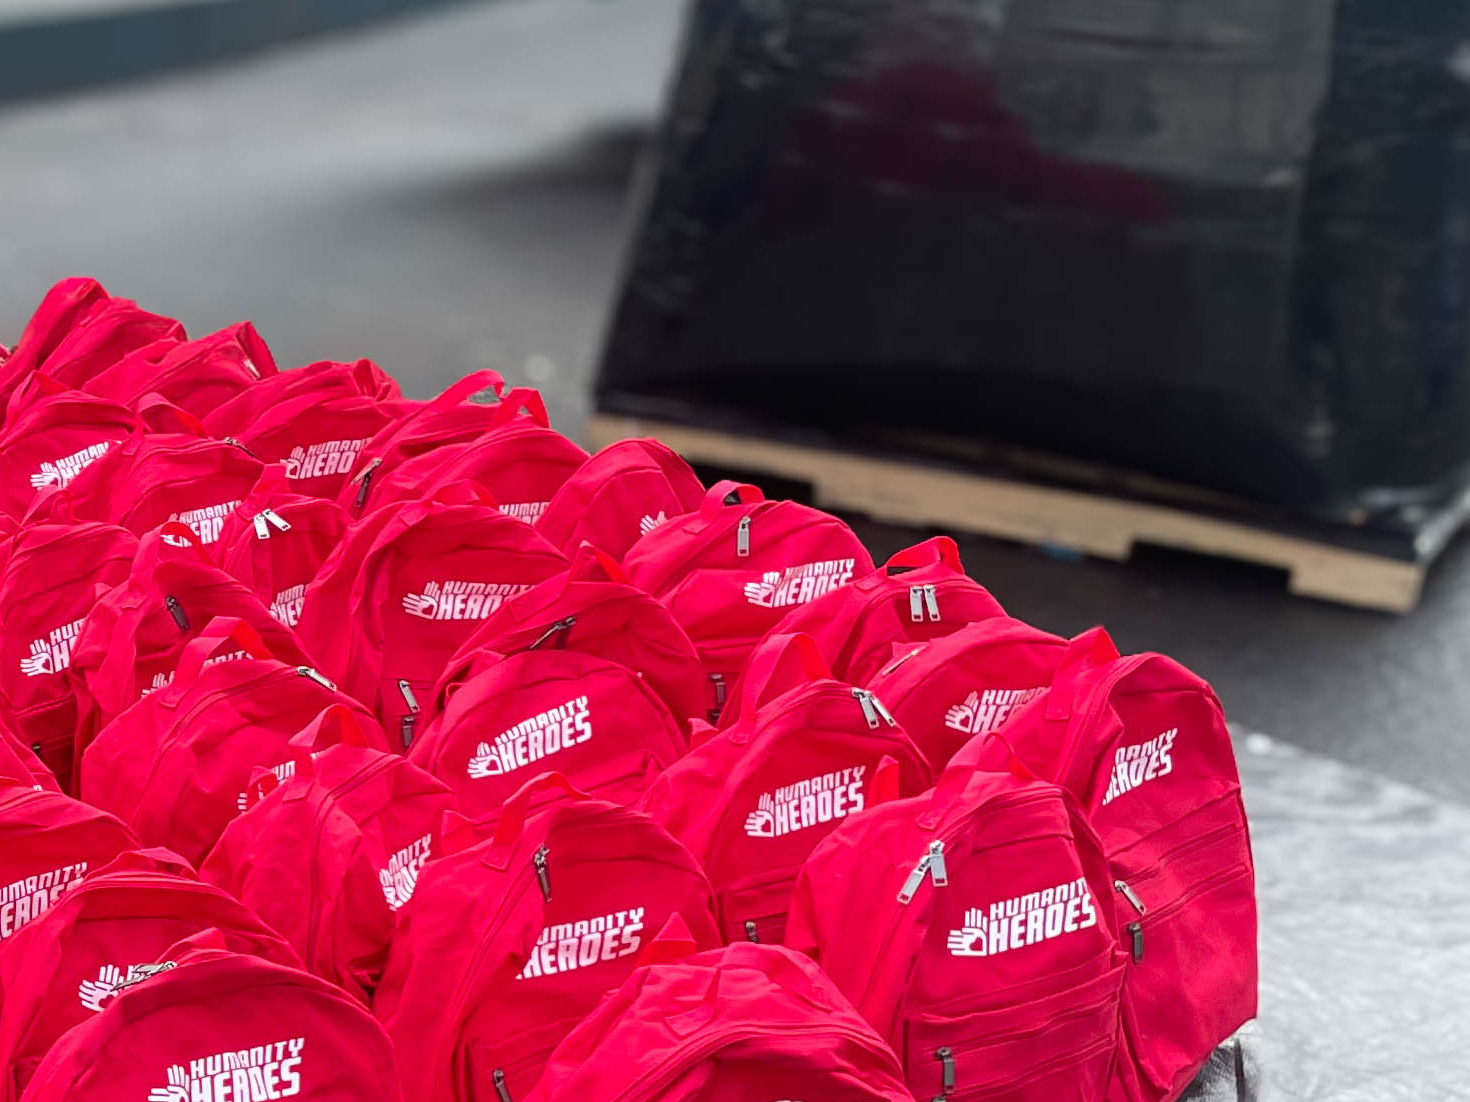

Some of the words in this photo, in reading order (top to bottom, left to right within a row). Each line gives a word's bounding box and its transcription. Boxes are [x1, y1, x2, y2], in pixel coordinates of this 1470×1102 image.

[301, 450, 357, 480] HERO
[435, 594, 508, 620] HERO
[494, 696, 588, 744] HUMANITY
[498, 711, 592, 773] HEROES
[775, 766, 865, 804] HUMANITY
[775, 780, 864, 837] HEROES
[536, 907, 644, 946] UMANITY
[988, 891, 1097, 955] HEROES
[190, 1038, 305, 1080] HUMANITY
